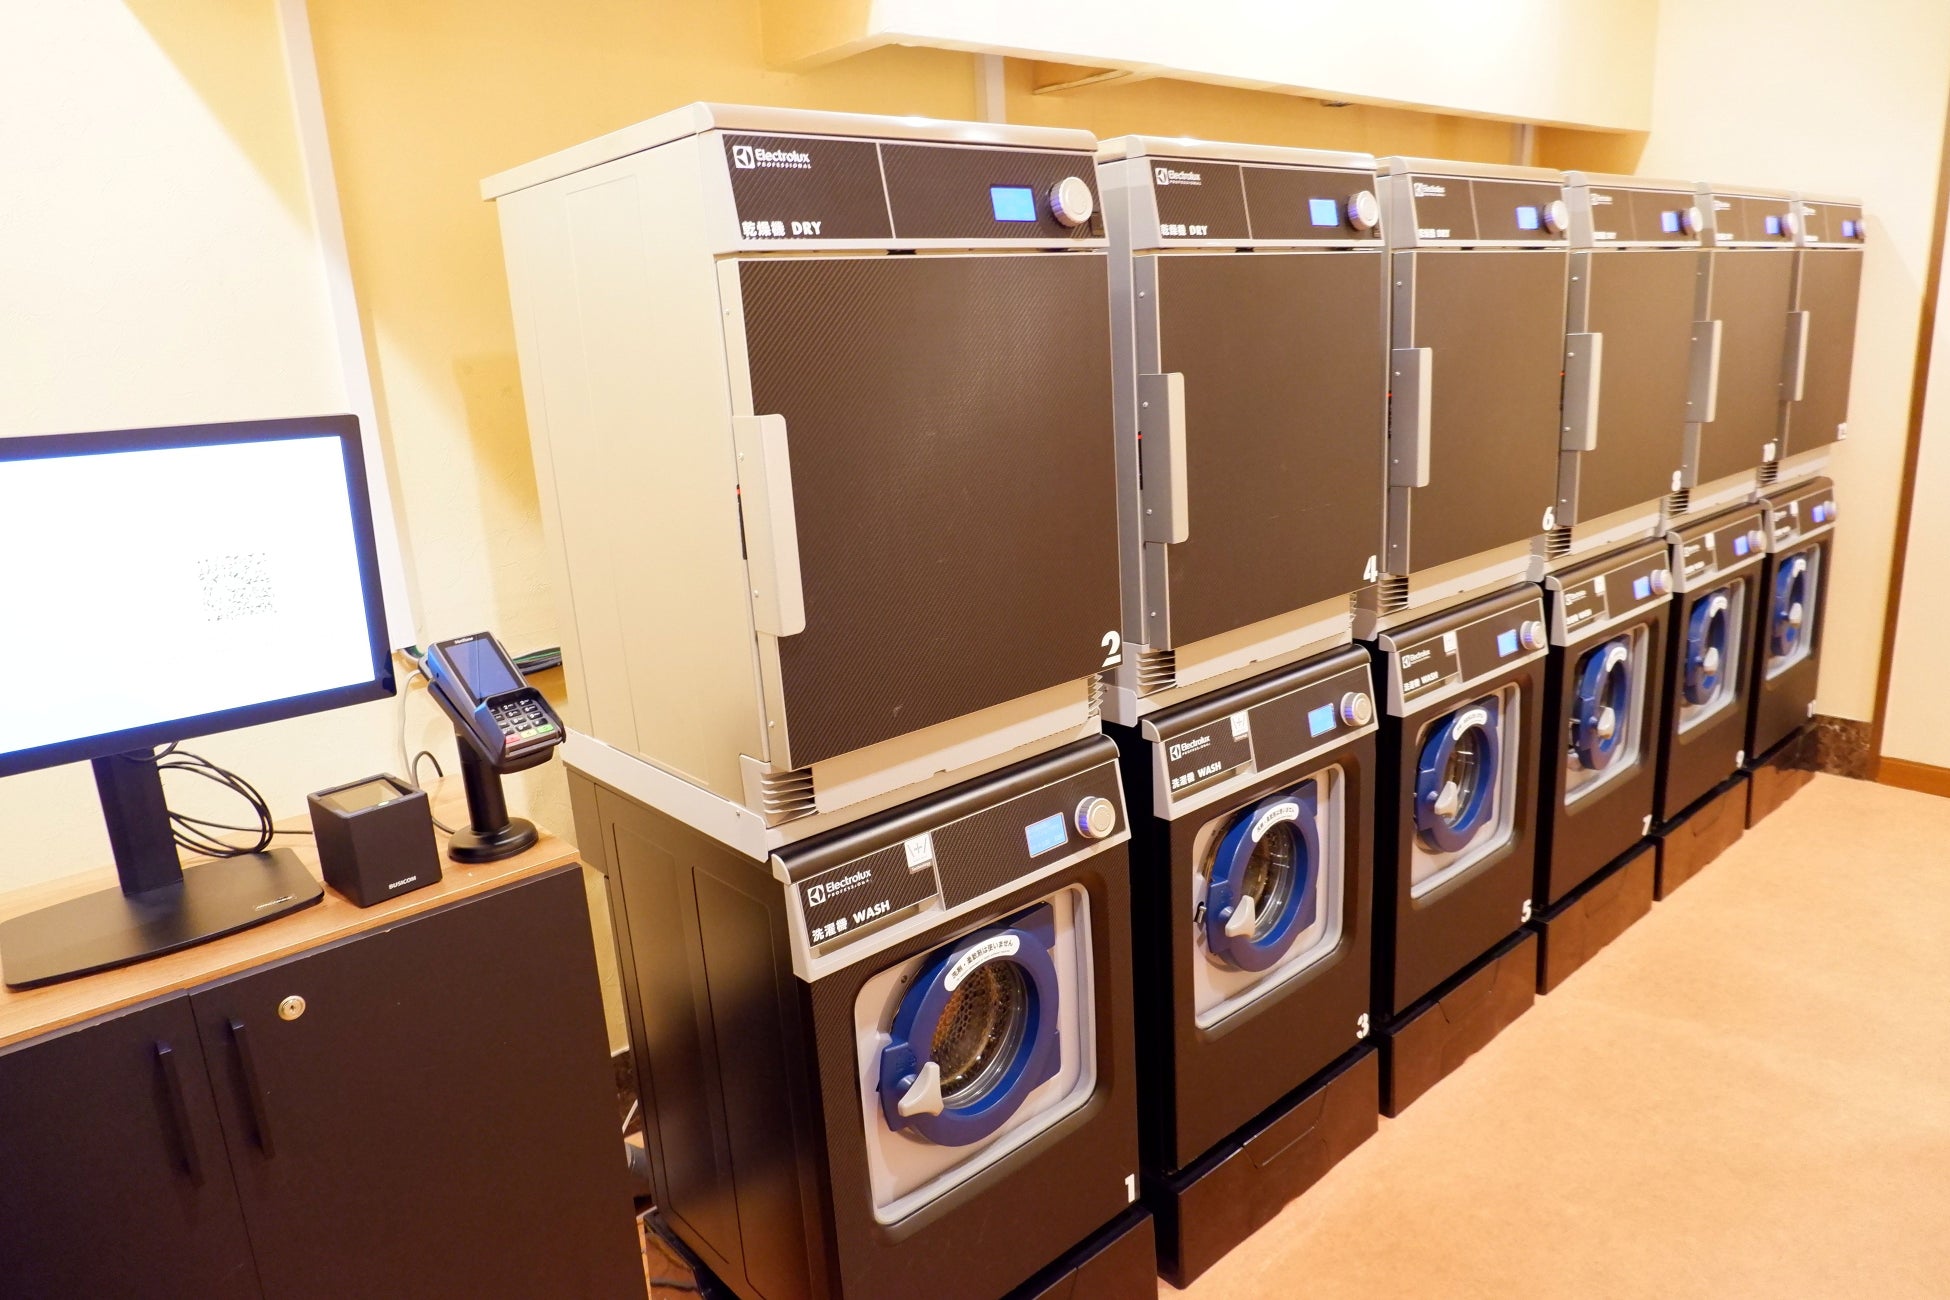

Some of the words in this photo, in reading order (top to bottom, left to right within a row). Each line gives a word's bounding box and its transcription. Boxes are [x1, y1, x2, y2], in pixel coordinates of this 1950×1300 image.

[755, 148, 811, 163] Electrolux
[757, 161, 812, 169] PROFESSIONAL
[1168, 170, 1202, 181] Electrolux
[791, 221, 821, 236] DRY
[1189, 225, 1208, 236] DRY
[1672, 470, 1681, 491] 8
[1542, 506, 1555, 531] 6
[1363, 554, 1378, 583] 4
[1101, 630, 1121, 668] 2
[1181, 735, 1211, 752] Electrolux
[1197, 761, 1222, 778] WASH
[388, 875, 417, 889] BUSICOM
[825, 869, 872, 893] Electrolux
[811, 918, 848, 943] 洗濯機
[853, 900, 891, 924] WASH
[1521, 899, 1531, 923] 5
[1356, 1012, 1369, 1039] 3
[1124, 1173, 1135, 1203] 1
